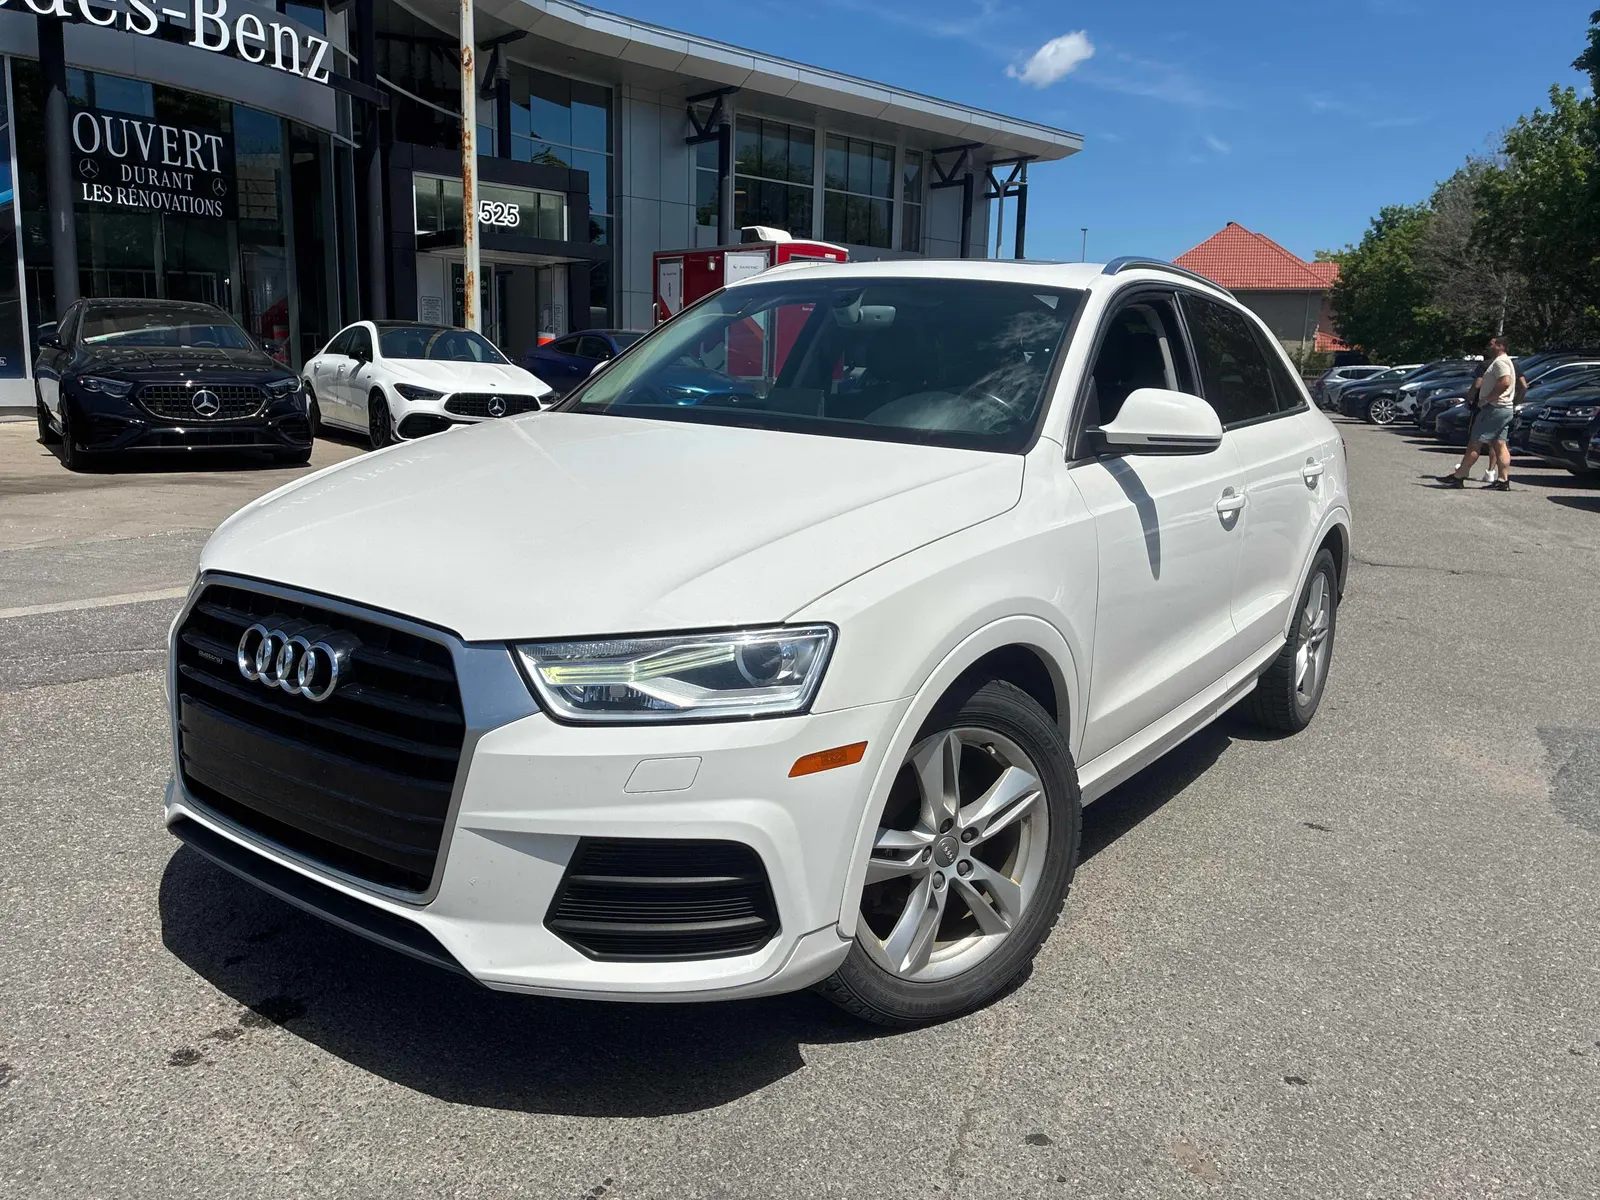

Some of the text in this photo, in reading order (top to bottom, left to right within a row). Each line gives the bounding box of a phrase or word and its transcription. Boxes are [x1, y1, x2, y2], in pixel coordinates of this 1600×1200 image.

[72, 111, 224, 174] OUVERT
[121, 163, 194, 191] DURANT
[82, 182, 223, 218] LES RÉNOVATIONS
[477, 200, 520, 227] 525
